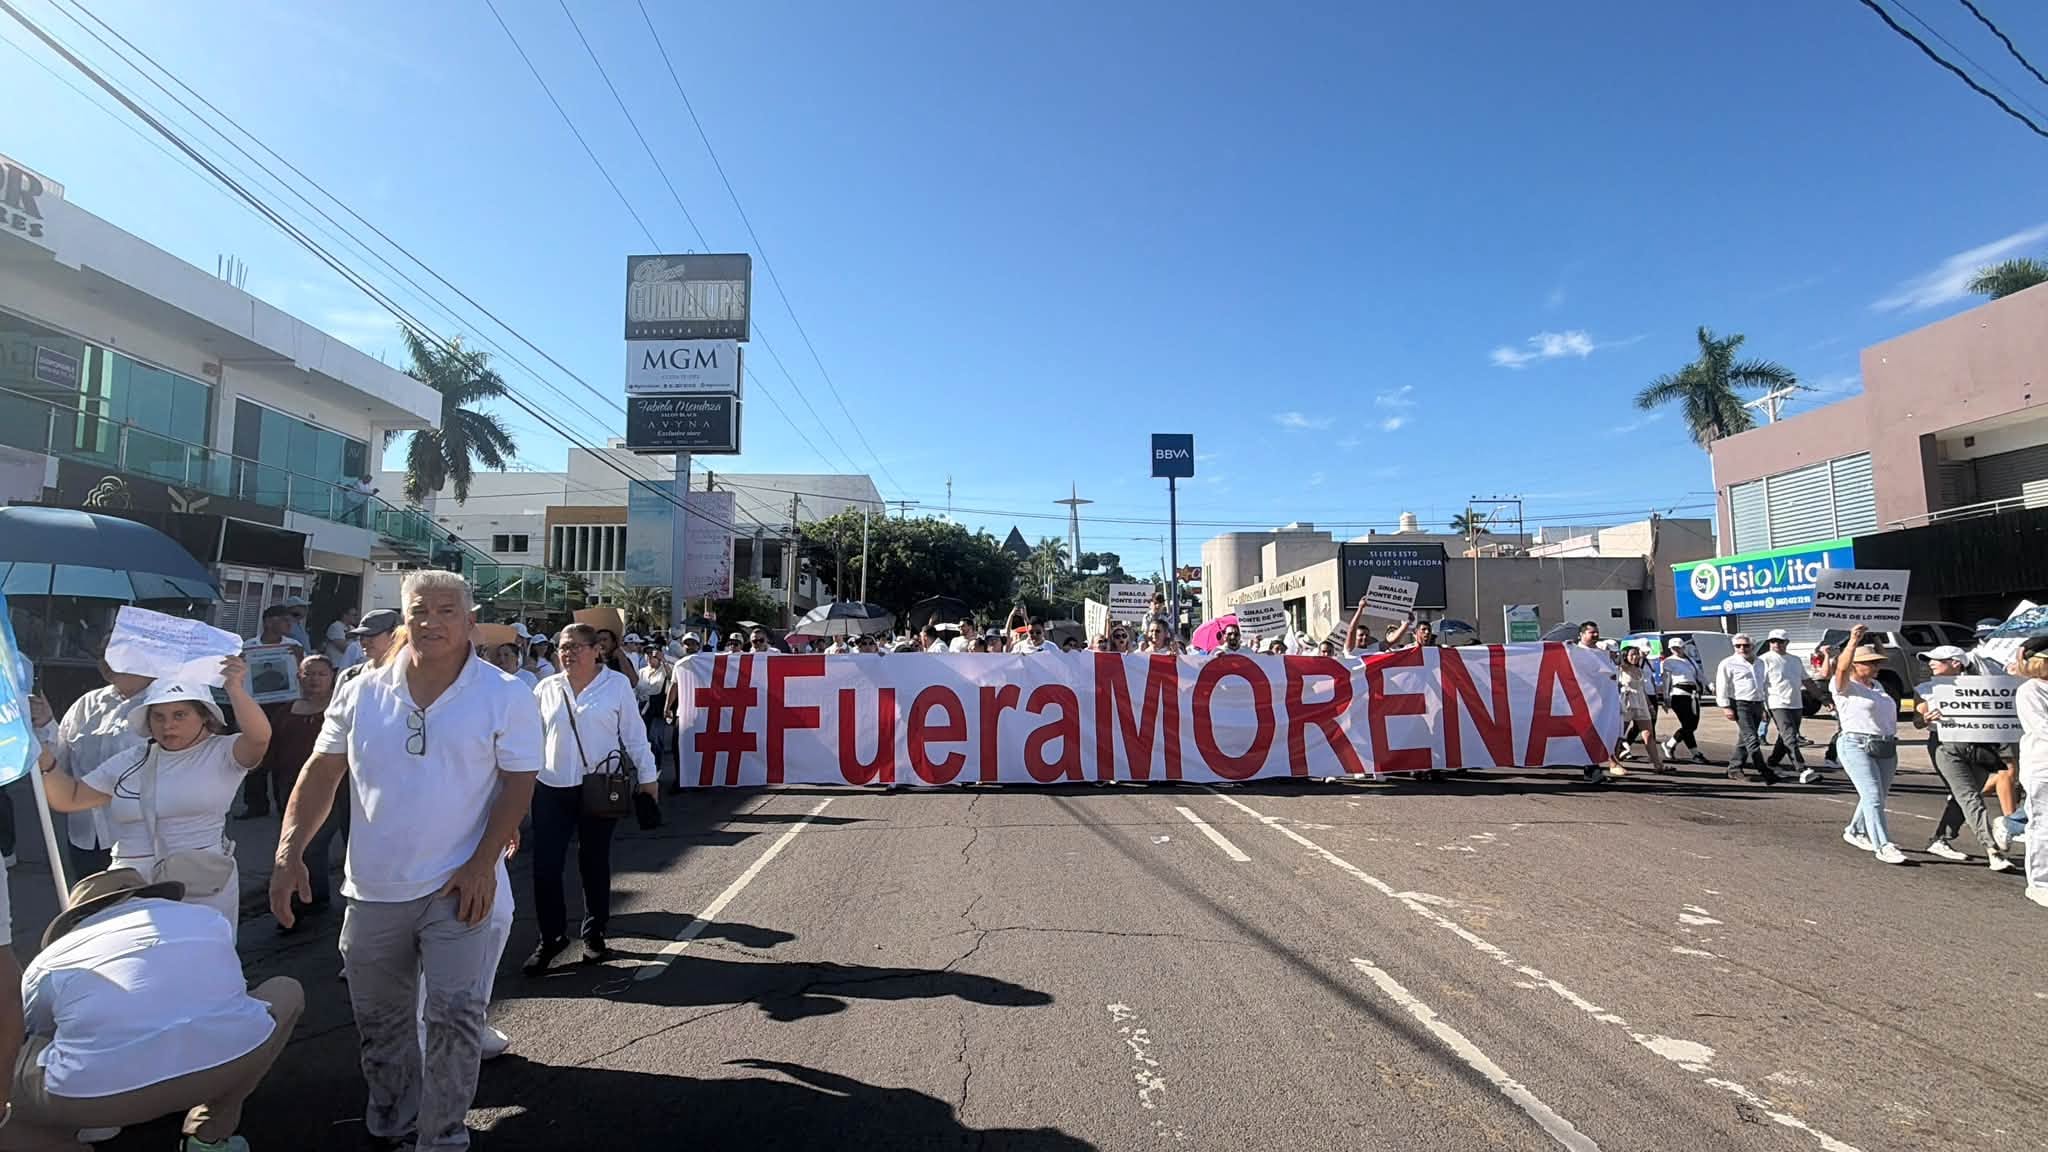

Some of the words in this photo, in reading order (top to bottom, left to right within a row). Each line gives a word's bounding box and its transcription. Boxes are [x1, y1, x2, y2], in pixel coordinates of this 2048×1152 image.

[629, 280, 745, 321] GUADALUPE
[642, 348, 719, 370] MGM
[638, 400, 673, 413] Fabiola
[675, 400, 721, 412] Mendoza
[1156, 449, 1190, 460] BBVA
[1378, 584, 1408, 595] SINALOA
[1834, 581, 1890, 590] SINALOA
[1368, 591, 1391, 599] PONTE
[1817, 592, 1861, 602] PONTE
[1865, 594, 1881, 602] DE
[1882, 594, 1904, 602] PIE
[1243, 607, 1275, 615] SINALOA
[1940, 701, 1992, 710] PONTE
[1994, 701, 2013, 710] DE
[694, 642, 1610, 786] #FueraMORENA
[1959, 721, 1980, 729] MÁS
